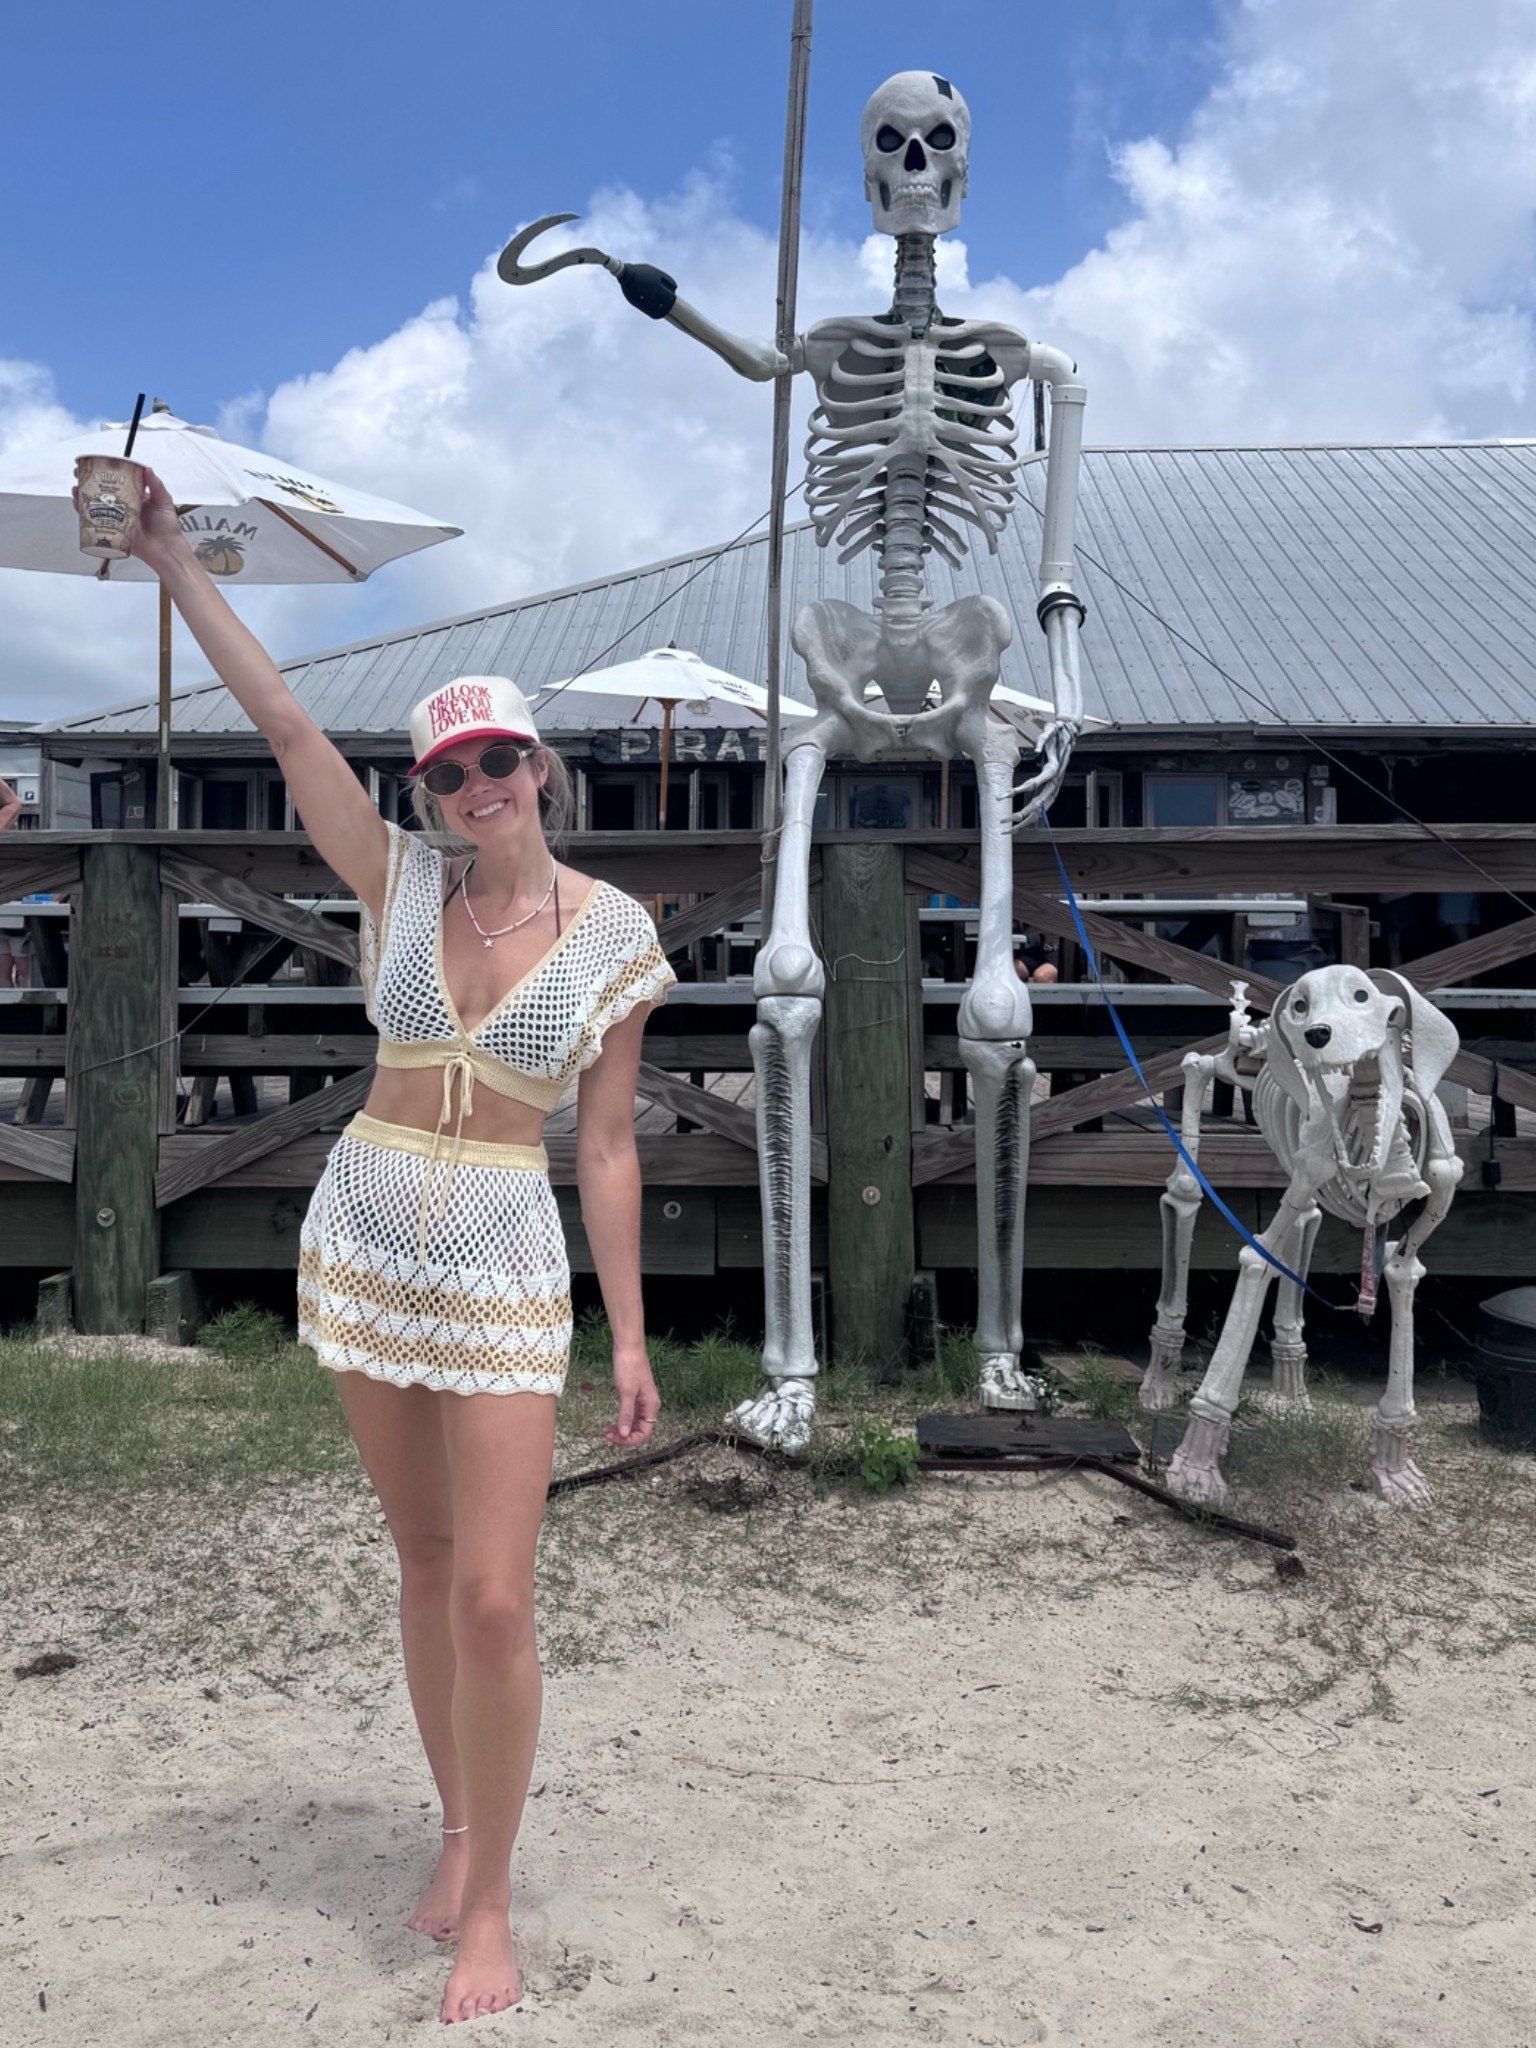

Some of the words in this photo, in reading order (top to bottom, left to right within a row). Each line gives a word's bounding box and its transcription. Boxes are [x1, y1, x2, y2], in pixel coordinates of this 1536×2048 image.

[450, 684, 493, 698] LOOK
[430, 698, 461, 725] LIKE
[461, 696, 492, 710] YOU
[432, 709, 470, 739] LOVE
[471, 709, 495, 722] ME
